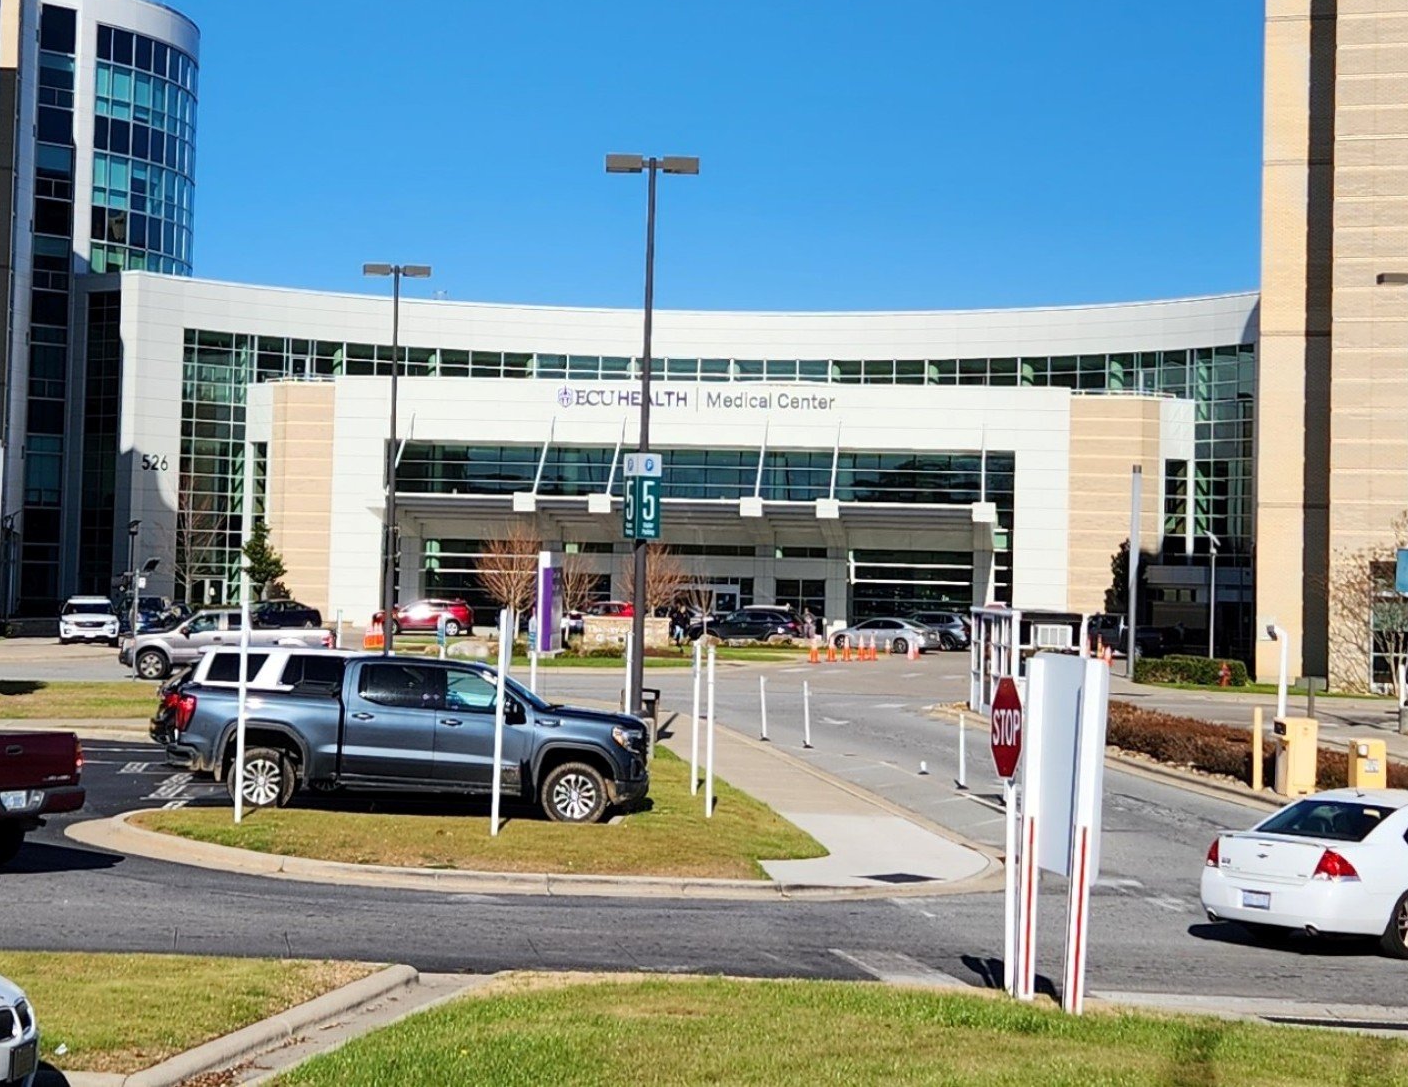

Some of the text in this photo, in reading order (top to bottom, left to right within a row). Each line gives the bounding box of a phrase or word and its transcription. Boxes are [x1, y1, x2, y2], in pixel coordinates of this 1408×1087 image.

[575, 390, 615, 406] ECU
[707, 391, 772, 409] Medical
[778, 393, 835, 410] Center
[142, 454, 168, 471] 526
[625, 481, 634, 520] 5
[642, 481, 655, 520] 5
[992, 709, 1021, 746] STOP
